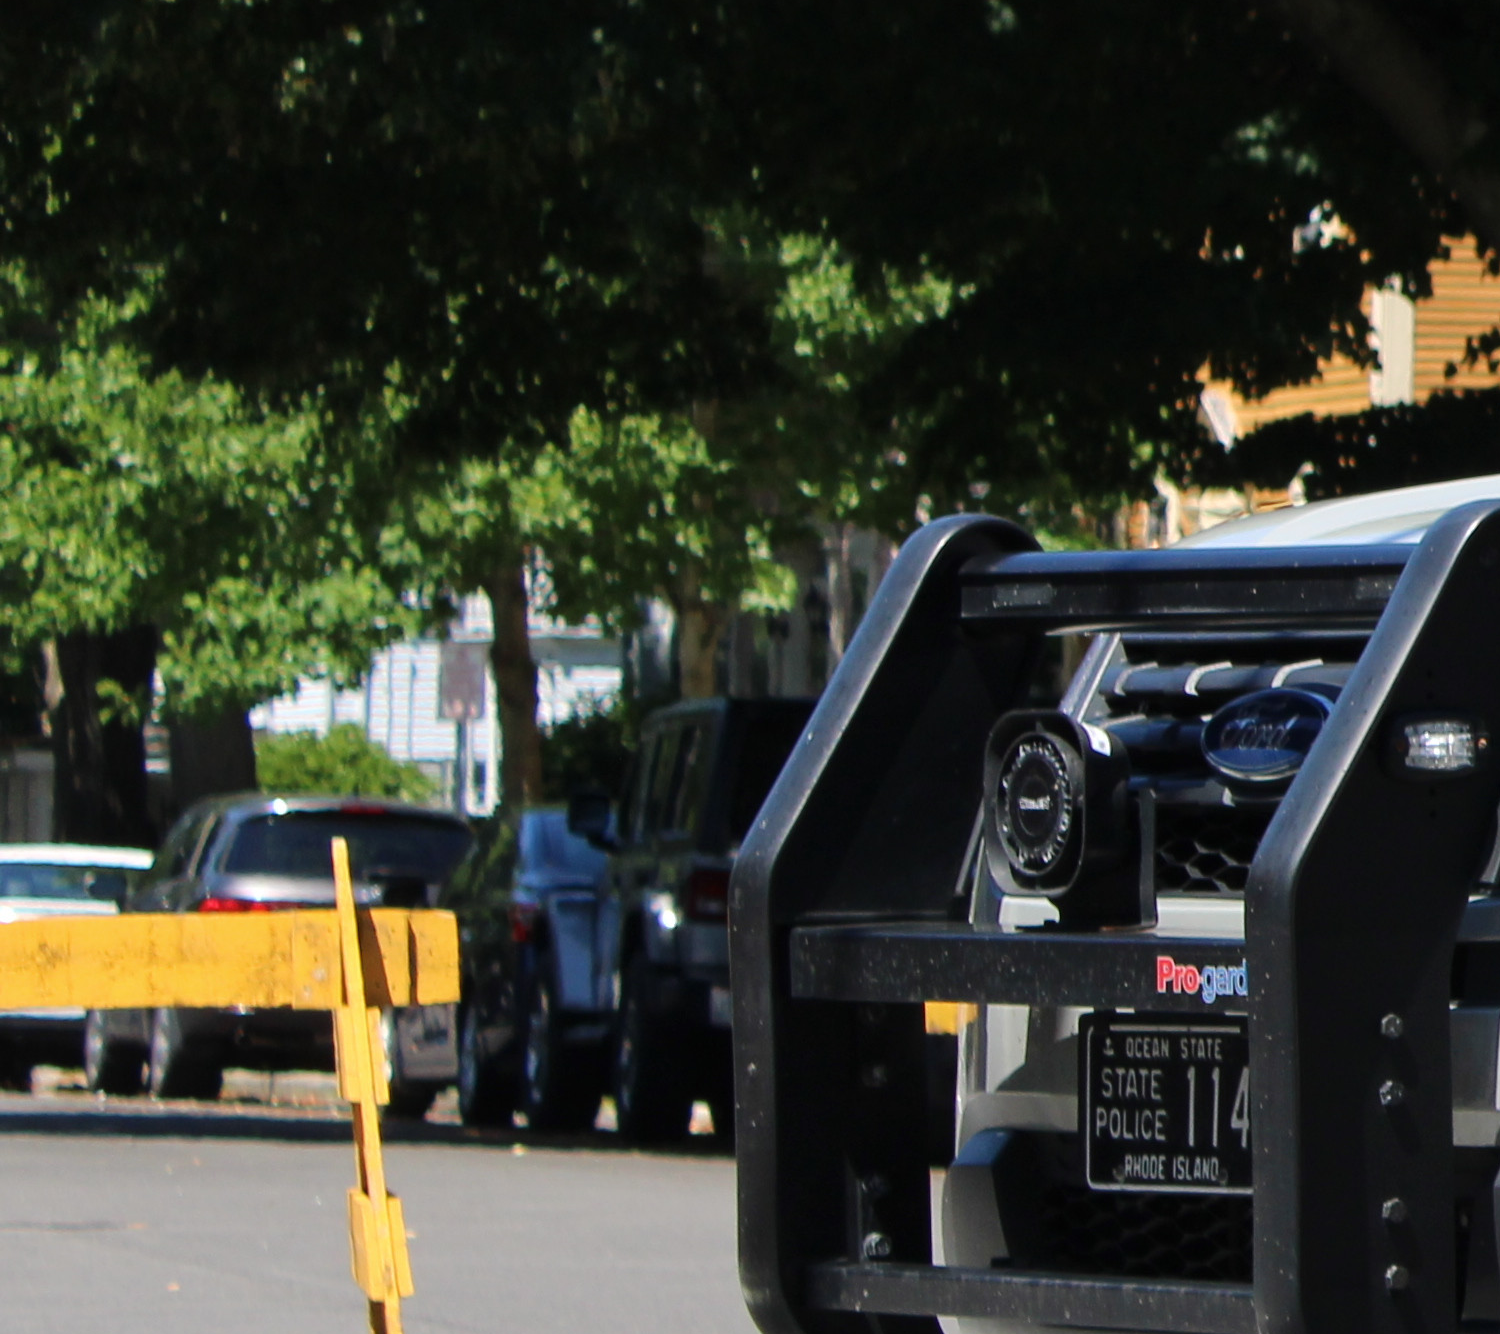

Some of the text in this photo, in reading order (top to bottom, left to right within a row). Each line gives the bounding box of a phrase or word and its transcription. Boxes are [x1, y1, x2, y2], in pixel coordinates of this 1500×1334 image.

[1126, 1036, 1222, 1060] OCEAN STATE
[1101, 1068, 1163, 1101] STATE
[1187, 1066, 1249, 1148] 114
[1096, 1107, 1167, 1142] POLICE
[1124, 1155, 1219, 1181] RHODE ISLAND
